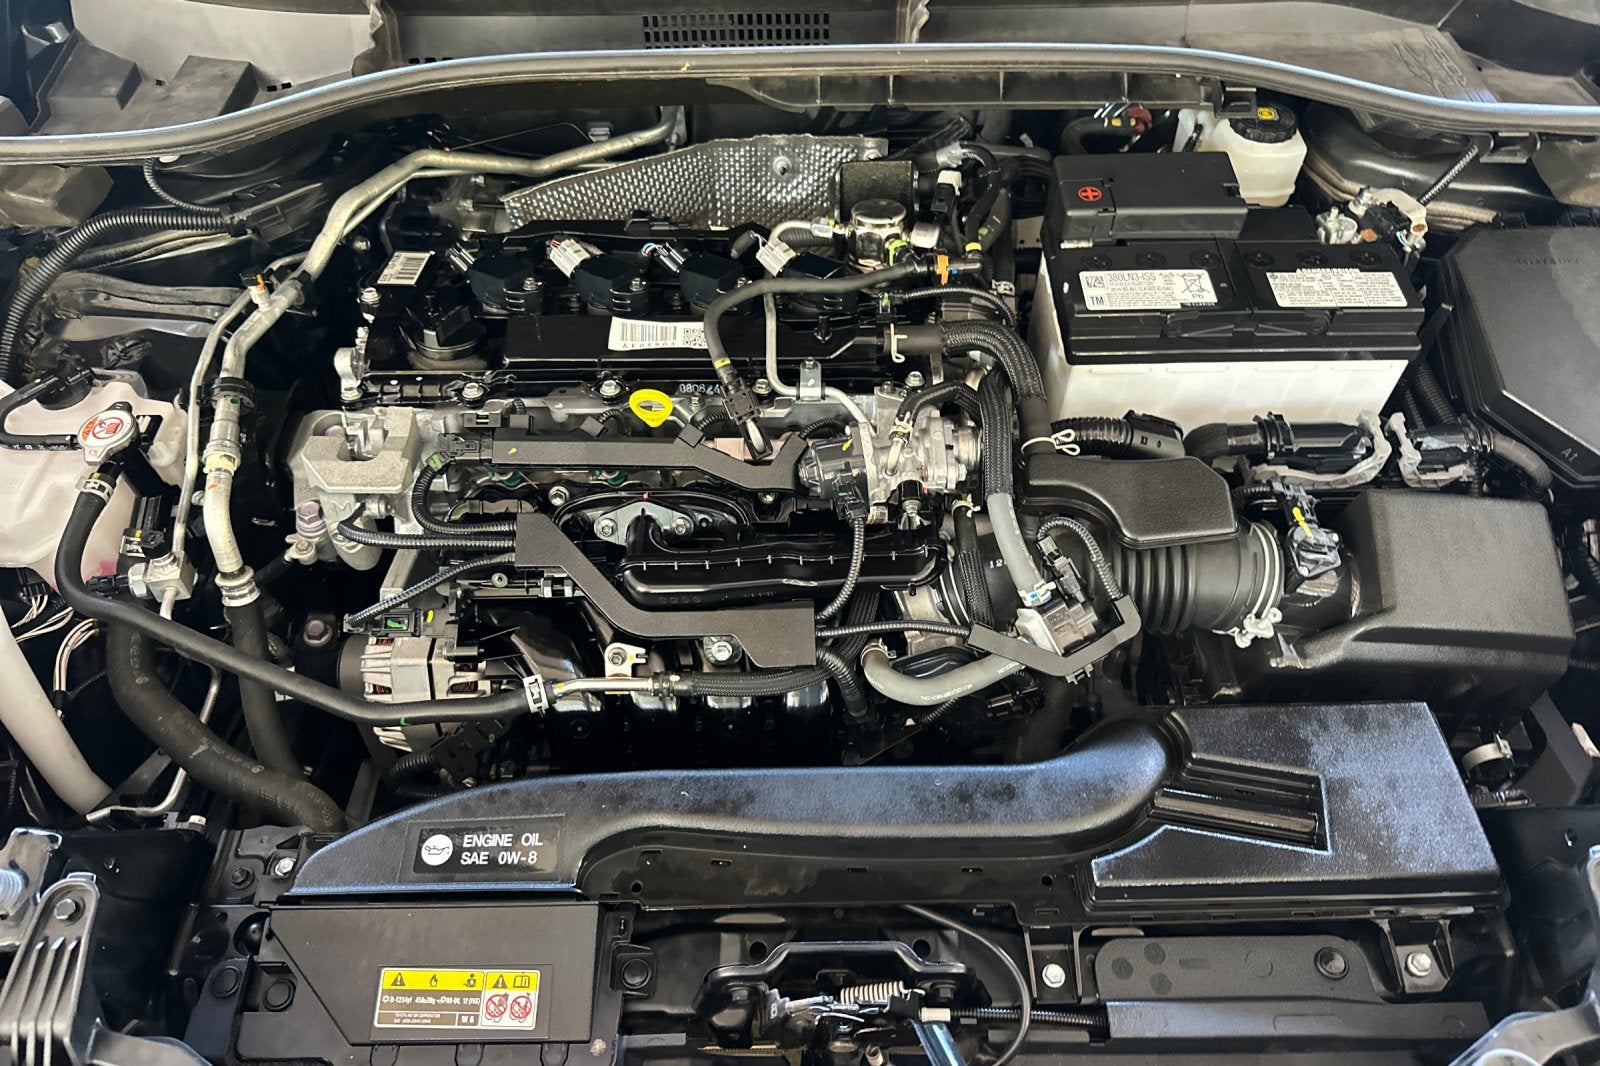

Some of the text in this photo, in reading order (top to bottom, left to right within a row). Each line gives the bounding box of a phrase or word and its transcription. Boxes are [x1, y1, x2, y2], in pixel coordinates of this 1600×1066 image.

[1090, 295, 1105, 306] TM
[462, 832, 544, 848] ENGINE OIL
[460, 850, 538, 865] SAE 0W-8
